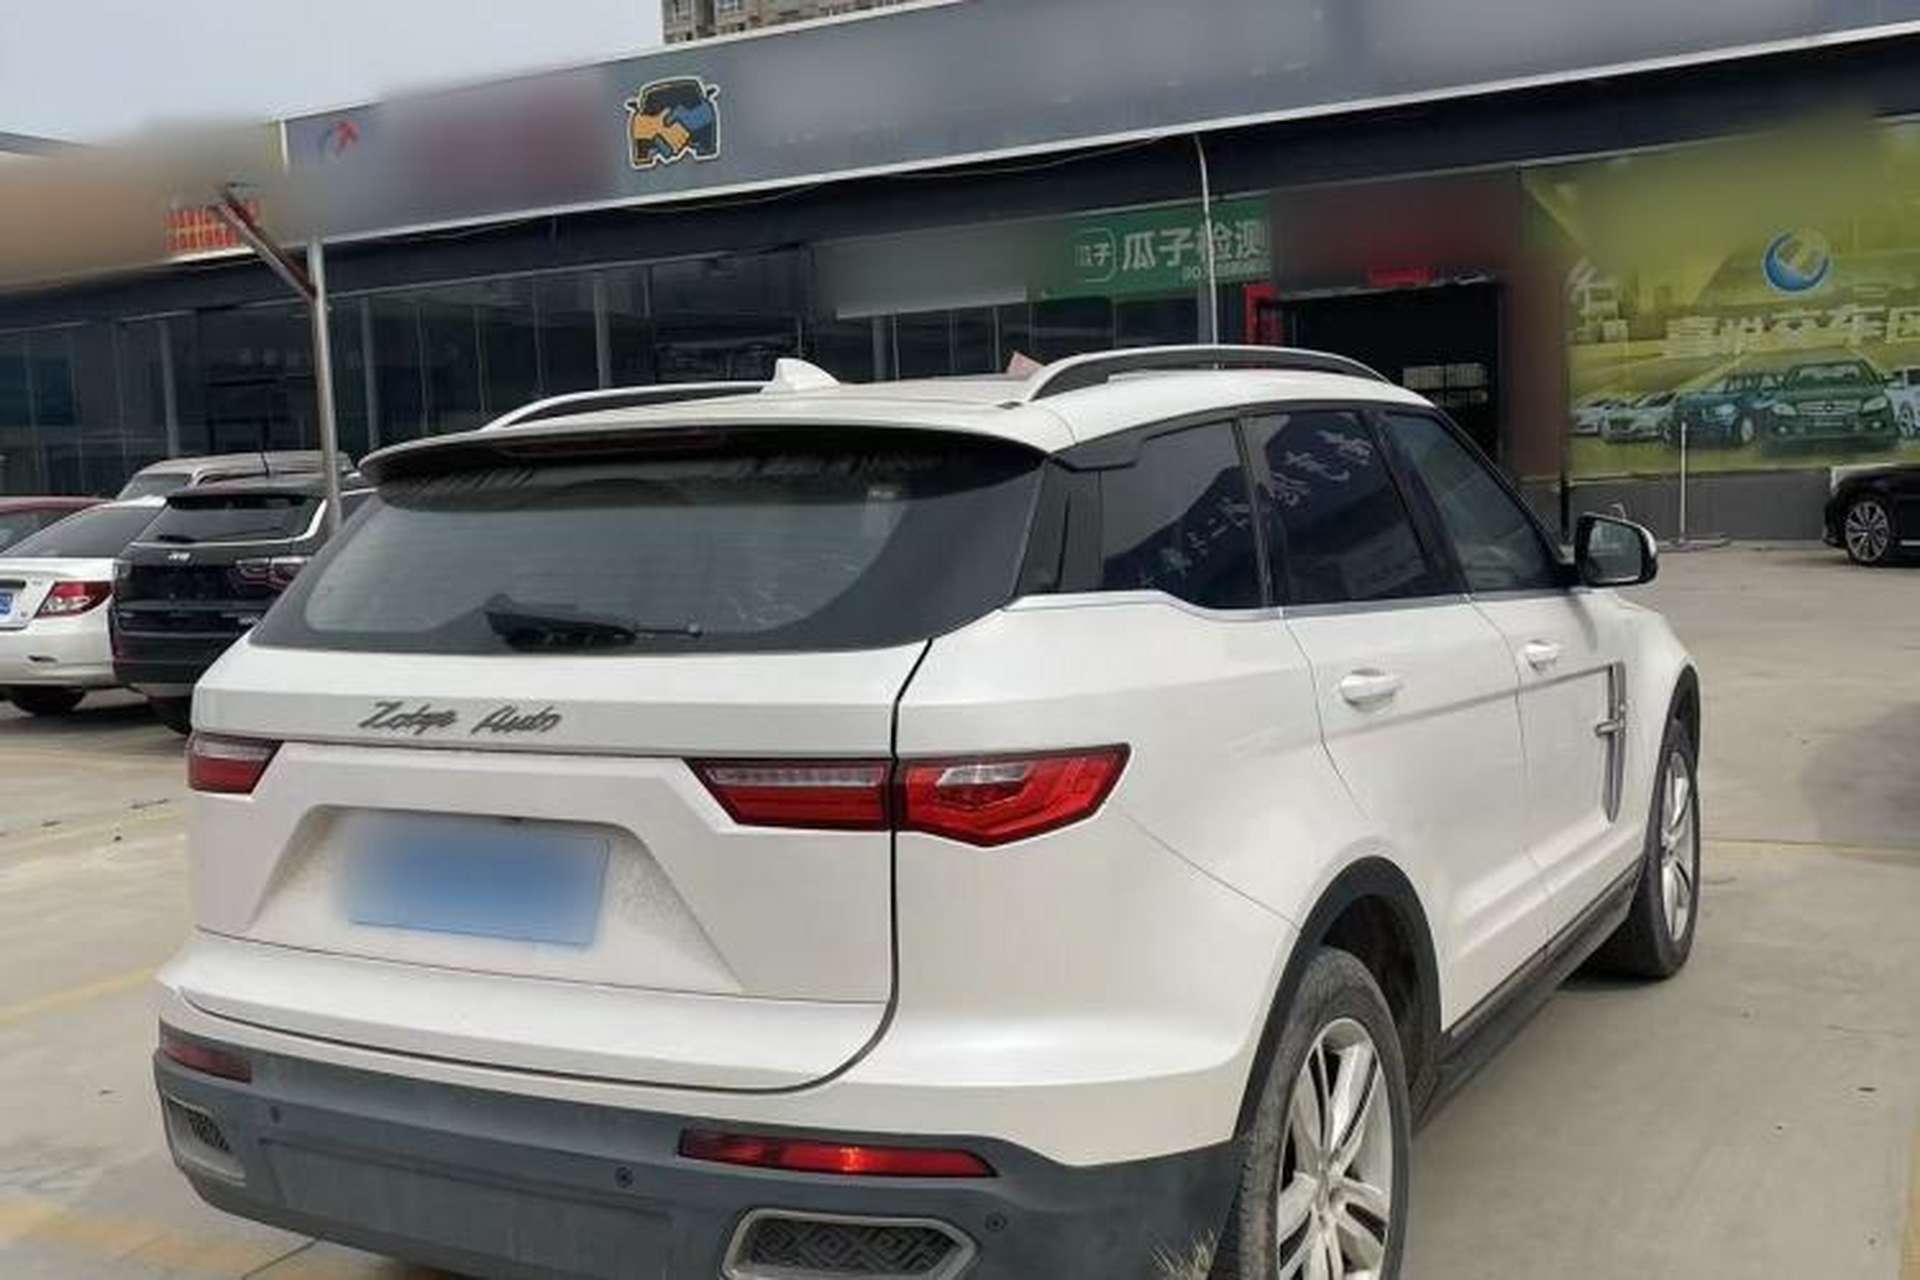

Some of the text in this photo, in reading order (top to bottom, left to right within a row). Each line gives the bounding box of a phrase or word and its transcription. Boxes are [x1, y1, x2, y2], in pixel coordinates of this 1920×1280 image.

[1122, 220, 1267, 272] 瓜子检测
[470, 704, 562, 734] Auto
